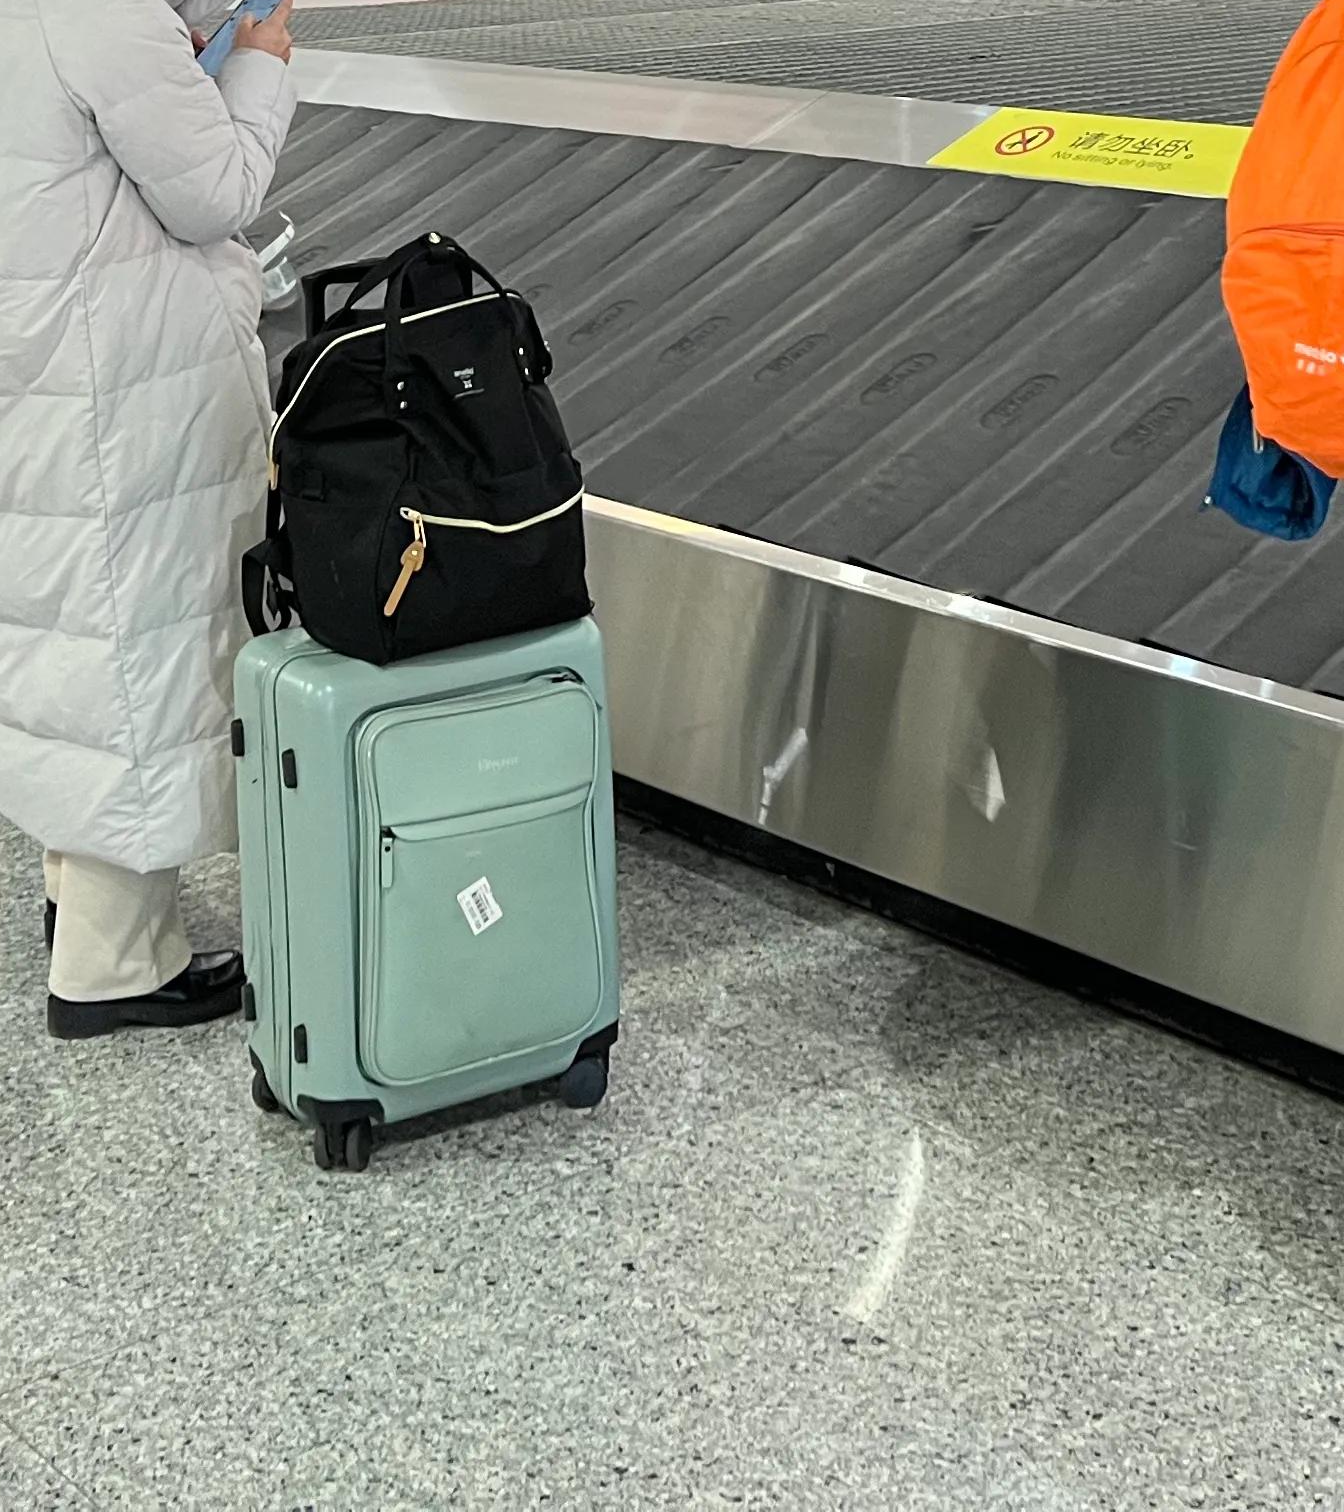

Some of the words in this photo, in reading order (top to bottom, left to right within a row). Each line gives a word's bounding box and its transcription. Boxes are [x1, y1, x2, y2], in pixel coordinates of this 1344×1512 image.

[1051, 151, 1072, 159] No
[1072, 153, 1117, 166] sitting
[1118, 158, 1136, 166] or
